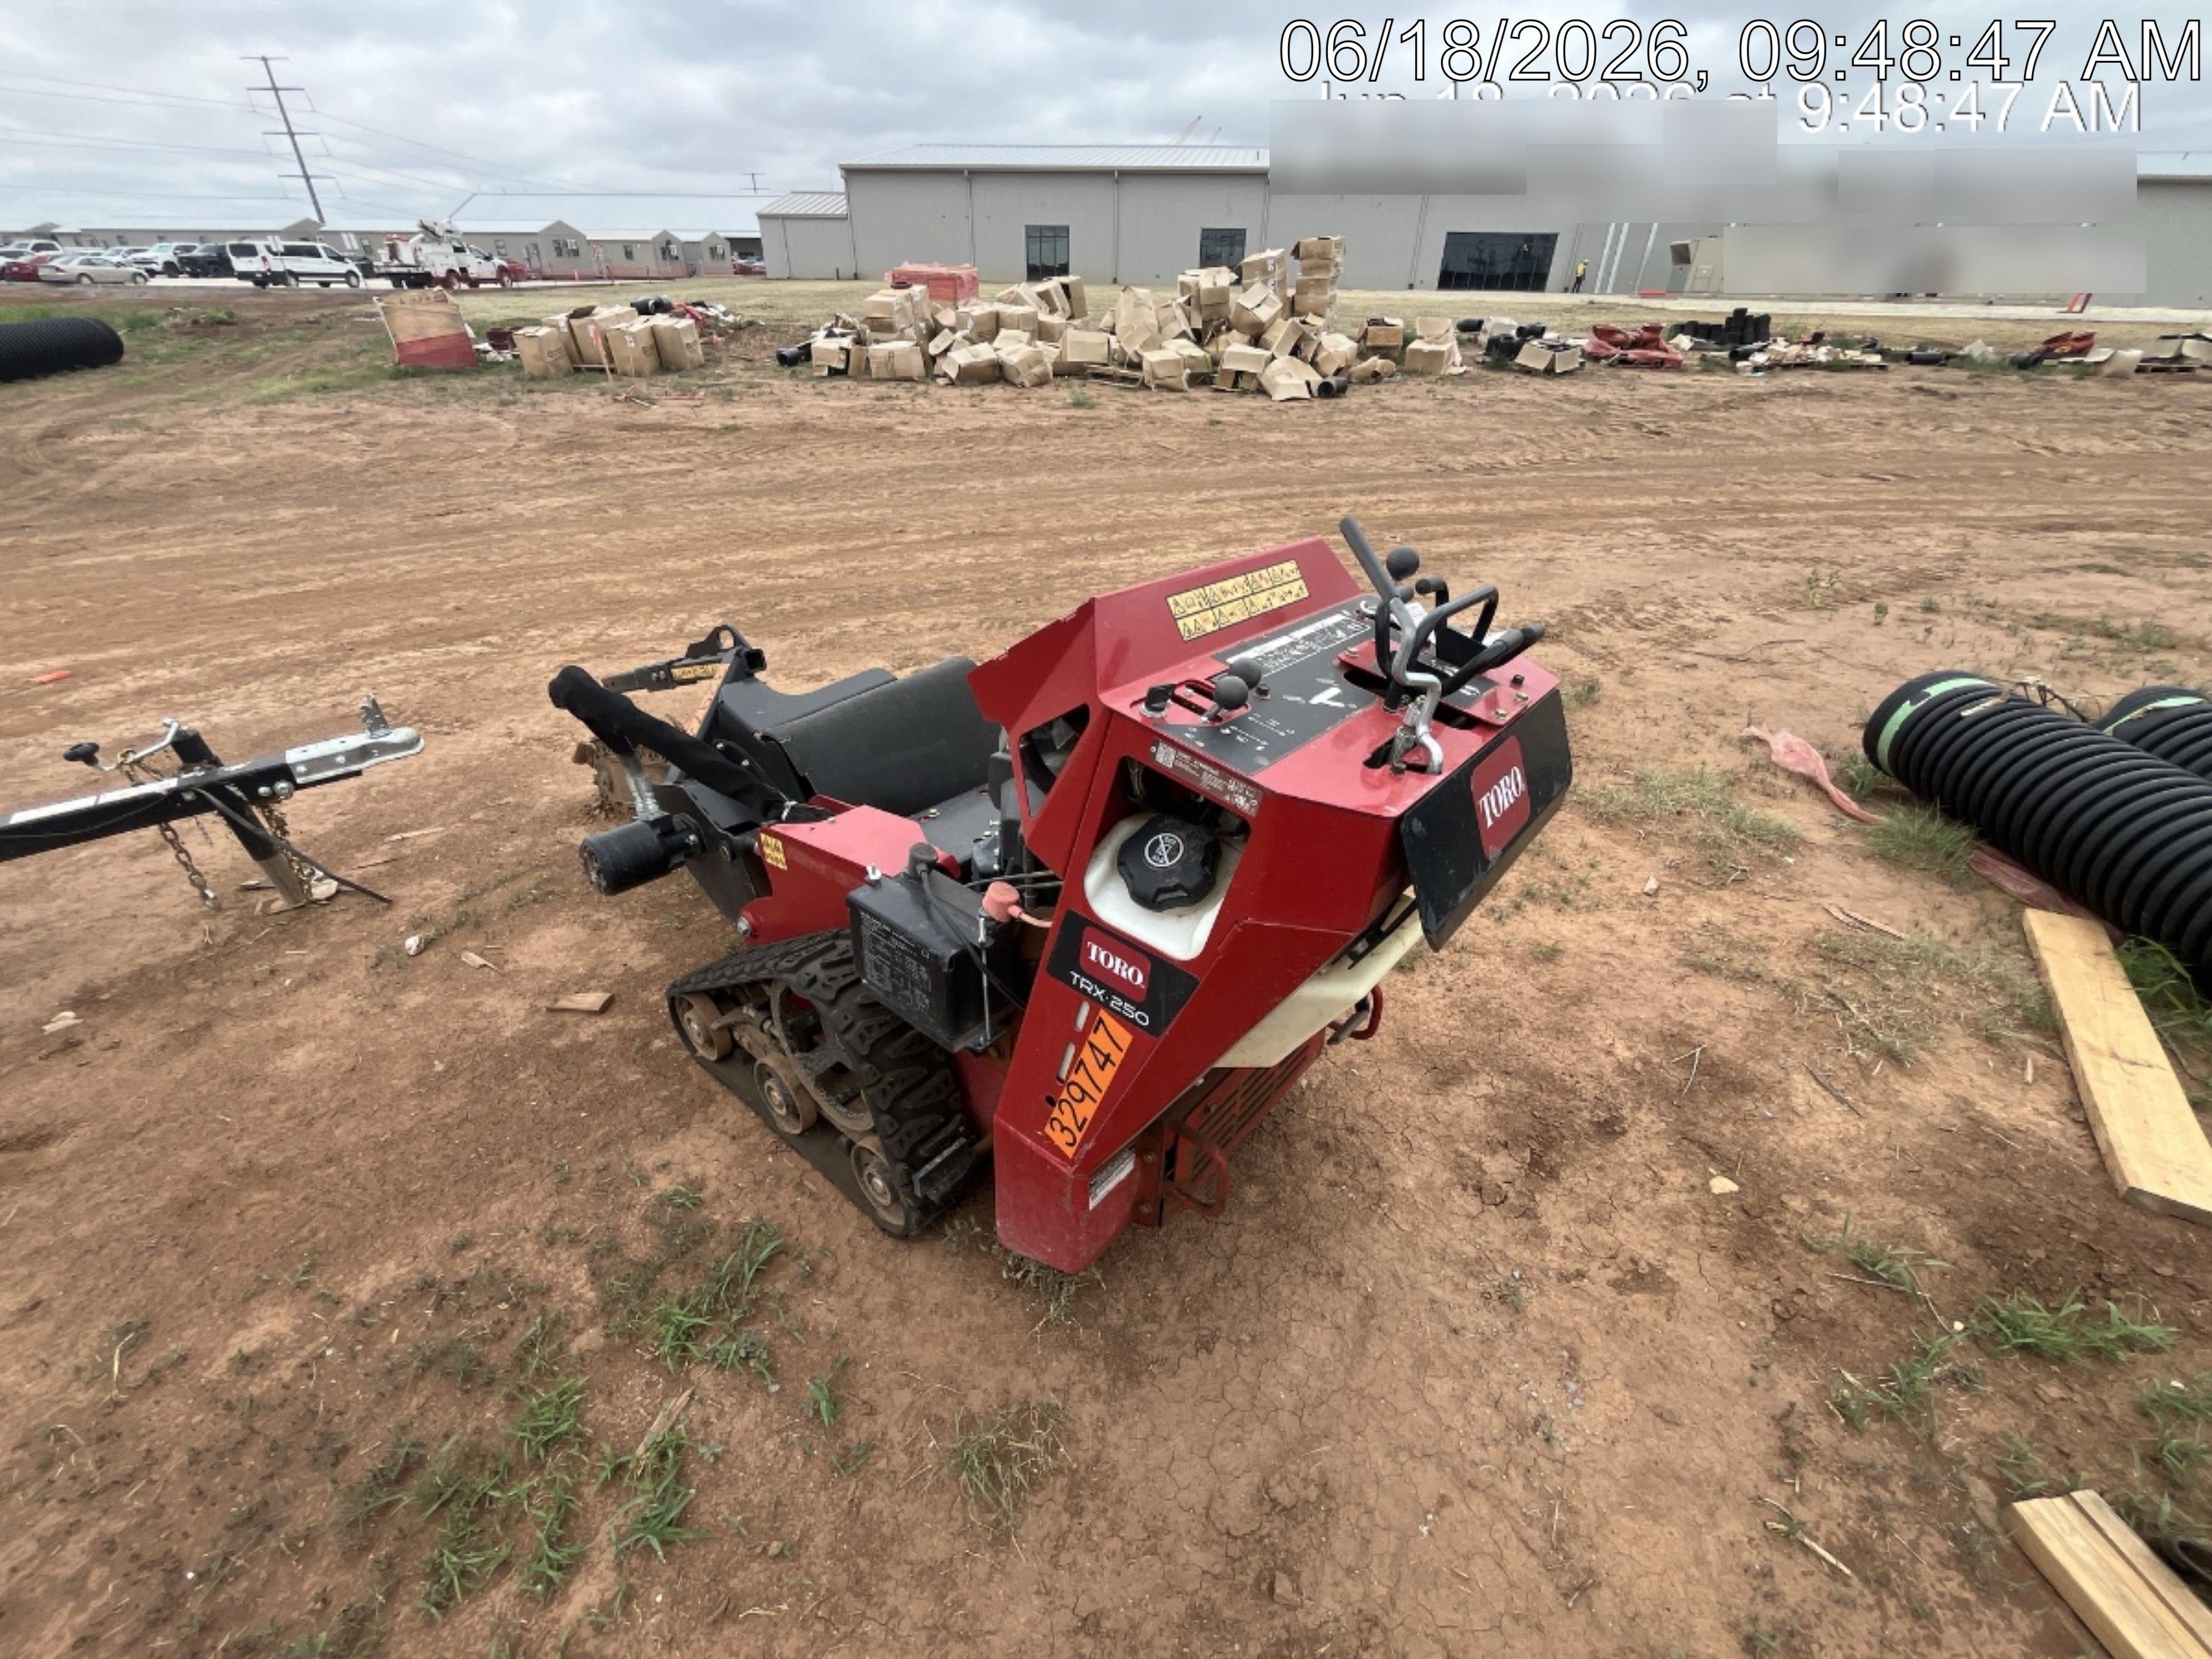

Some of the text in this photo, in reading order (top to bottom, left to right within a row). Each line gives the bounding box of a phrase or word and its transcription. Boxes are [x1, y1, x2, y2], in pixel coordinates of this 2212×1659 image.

[1478, 766, 1523, 828] TORO
[1087, 941, 1144, 986] TORO
[1049, 1016, 1124, 1148] 329747
